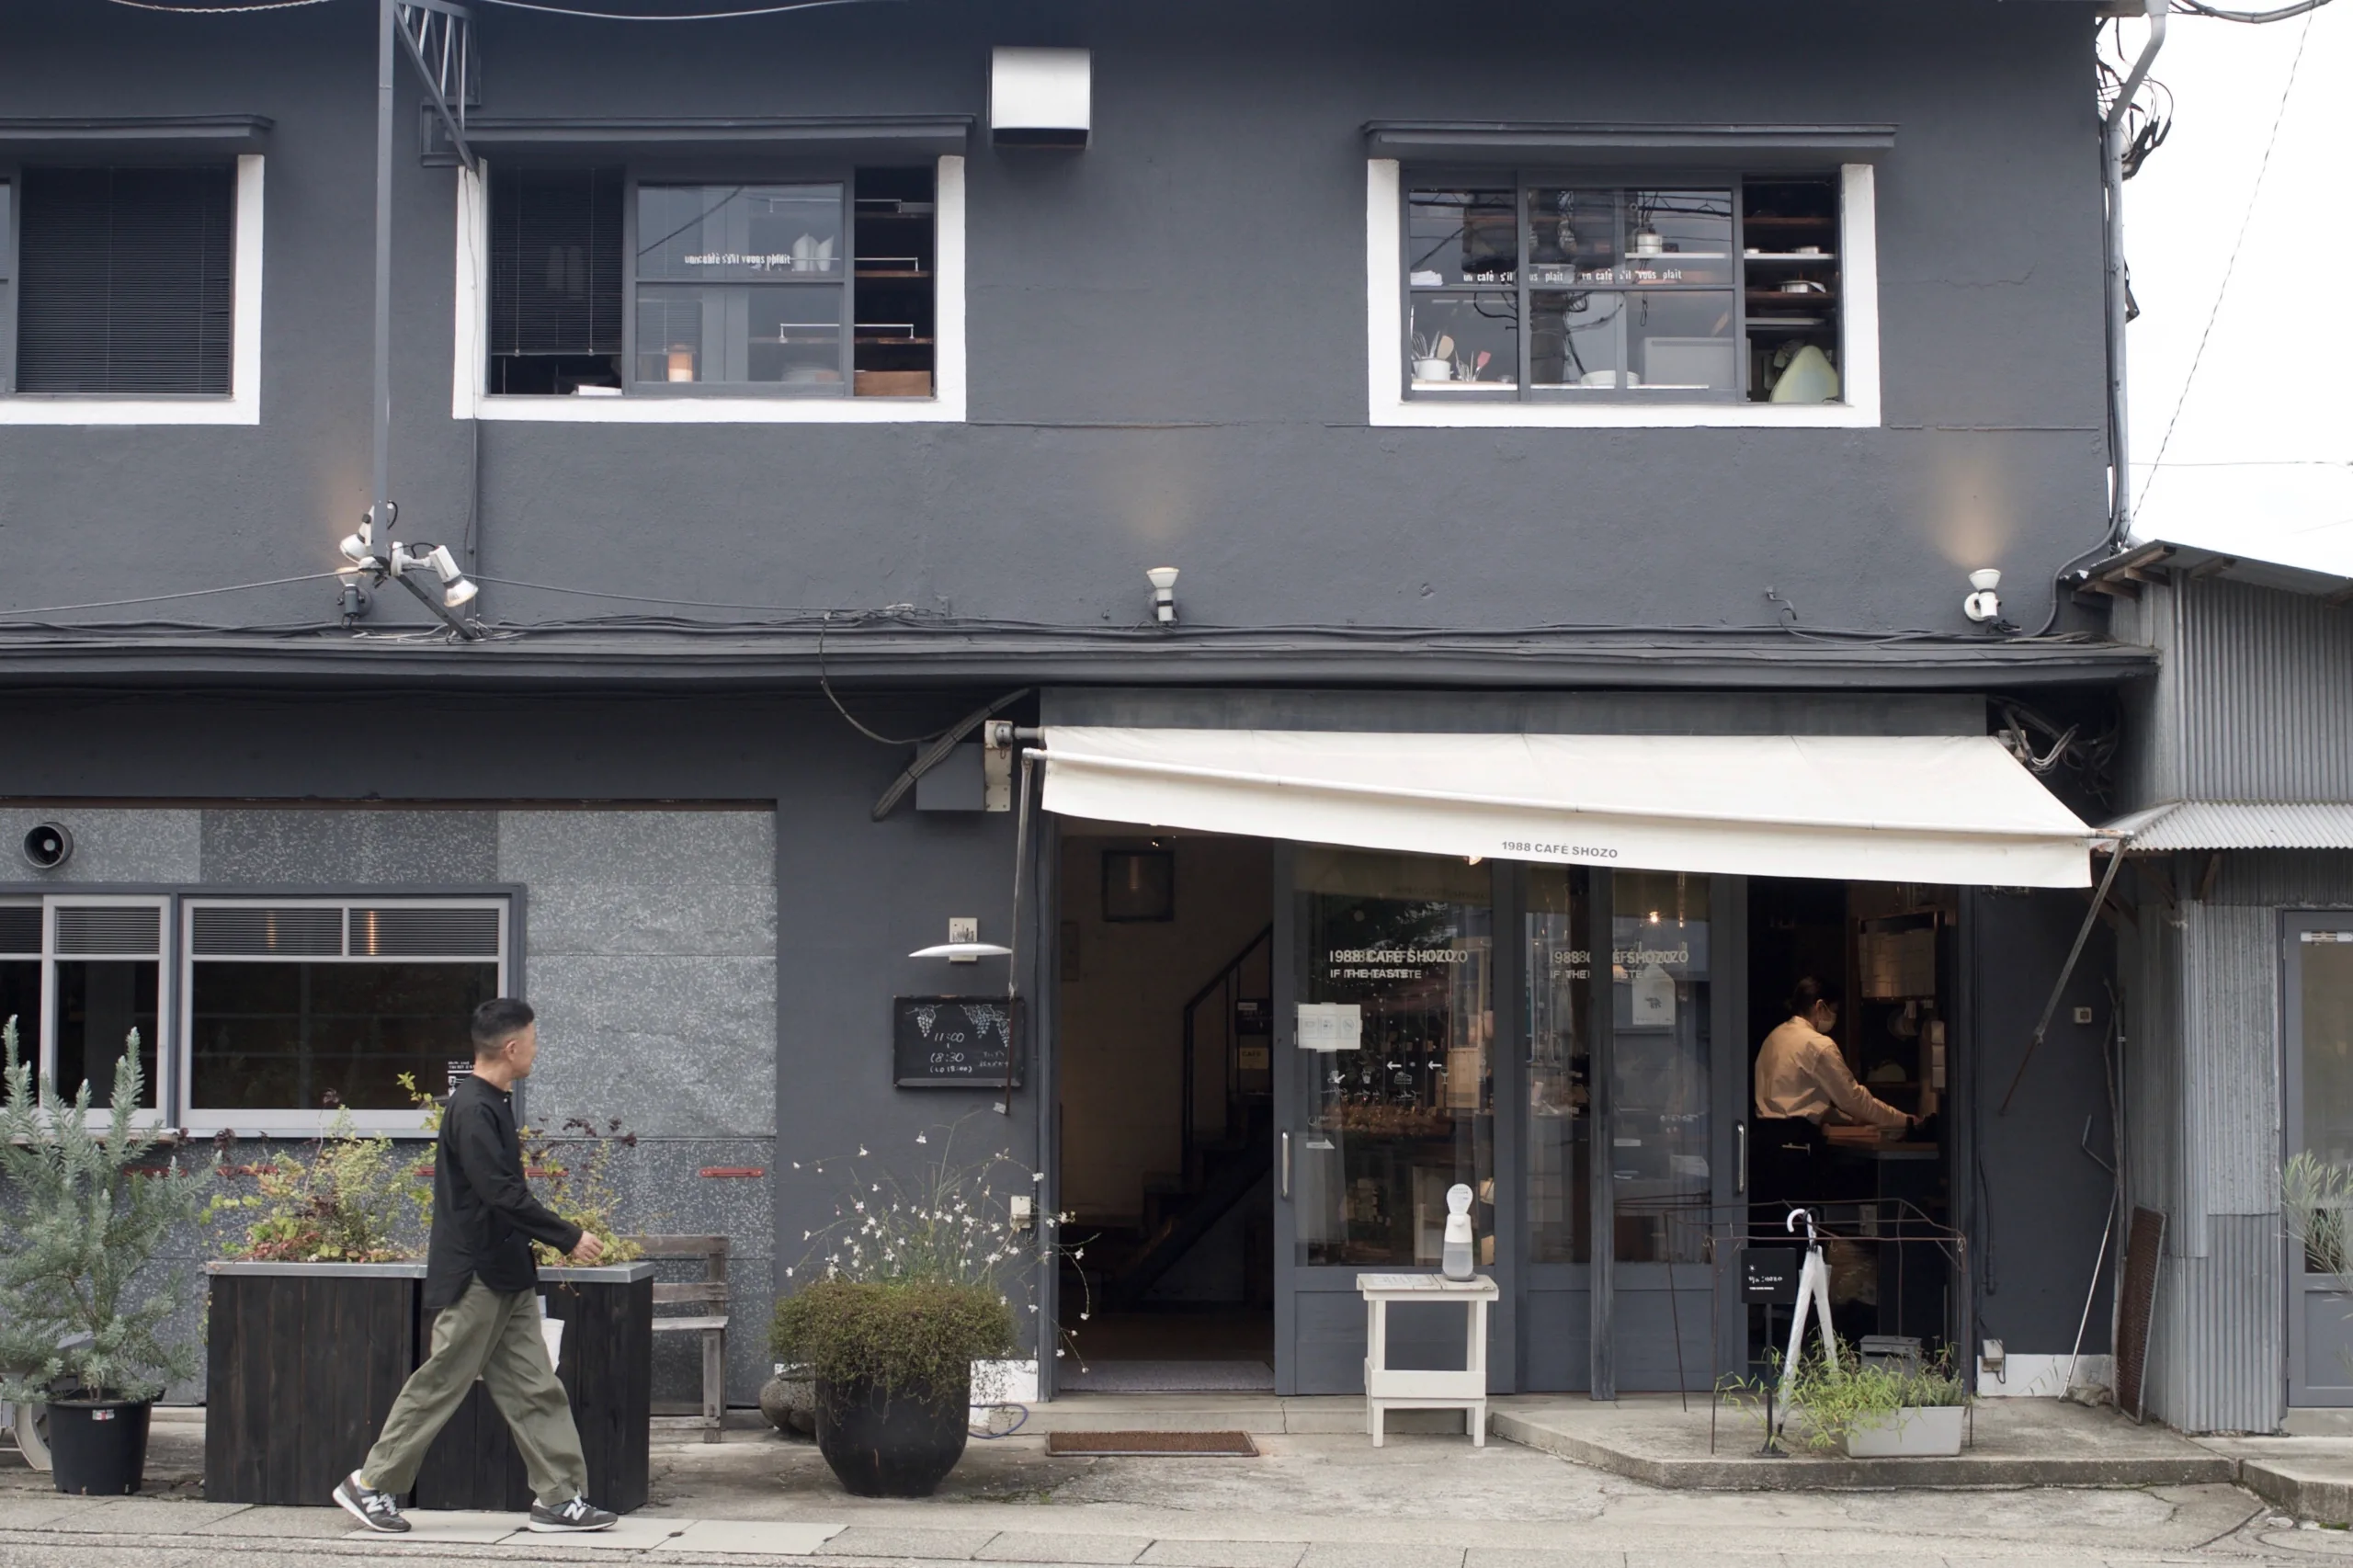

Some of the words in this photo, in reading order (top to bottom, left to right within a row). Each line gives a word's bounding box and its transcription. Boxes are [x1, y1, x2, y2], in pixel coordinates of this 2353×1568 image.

[1463, 273, 1473, 281] un
[1500, 272, 1513, 282] s'il
[1545, 271, 1563, 283] plait
[1637, 270, 1657, 280] vous
[1663, 268, 1682, 282] plait
[1501, 840, 1531, 852] 1988
[1572, 846, 1618, 858] SHOZO
[1329, 949, 1361, 963] 1988
[1406, 949, 1456, 963] SHOZO
[1549, 950, 1580, 964] 1988
[1626, 949, 1677, 964] SHOZO
[1329, 970, 1341, 979] IF
[1347, 970, 1369, 979] THE
[1372, 970, 1410, 979] TASTE
[1550, 970, 1560, 979] IF
[934, 1032, 965, 1043] 11:00
[930, 1051, 965, 1063] 18:30
[361, 1494, 385, 1513] N
[562, 1502, 587, 1521] N
